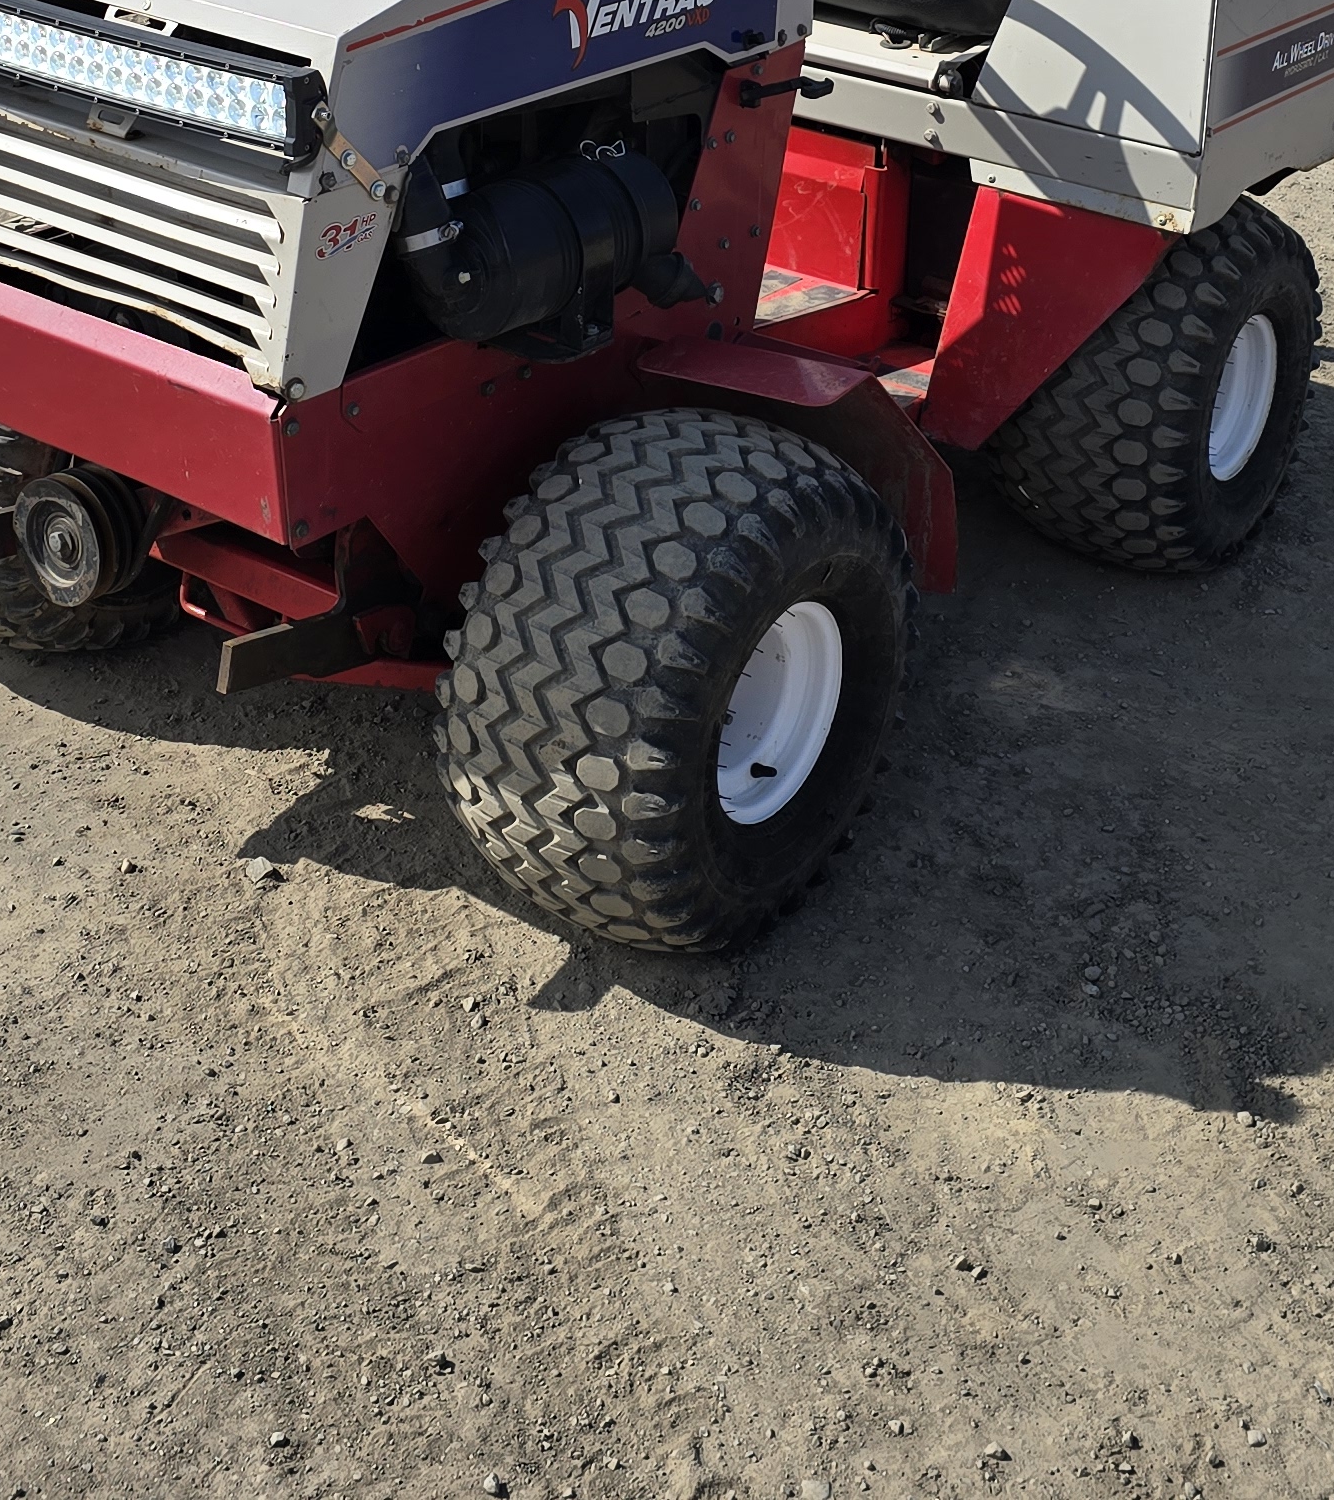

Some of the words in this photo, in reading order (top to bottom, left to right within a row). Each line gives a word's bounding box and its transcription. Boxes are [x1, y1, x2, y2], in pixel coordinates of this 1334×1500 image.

[1271, 50, 1288, 72] ALL
[316, 217, 359, 259] 31
[360, 212, 377, 227] HP
[357, 230, 374, 243] GAS
